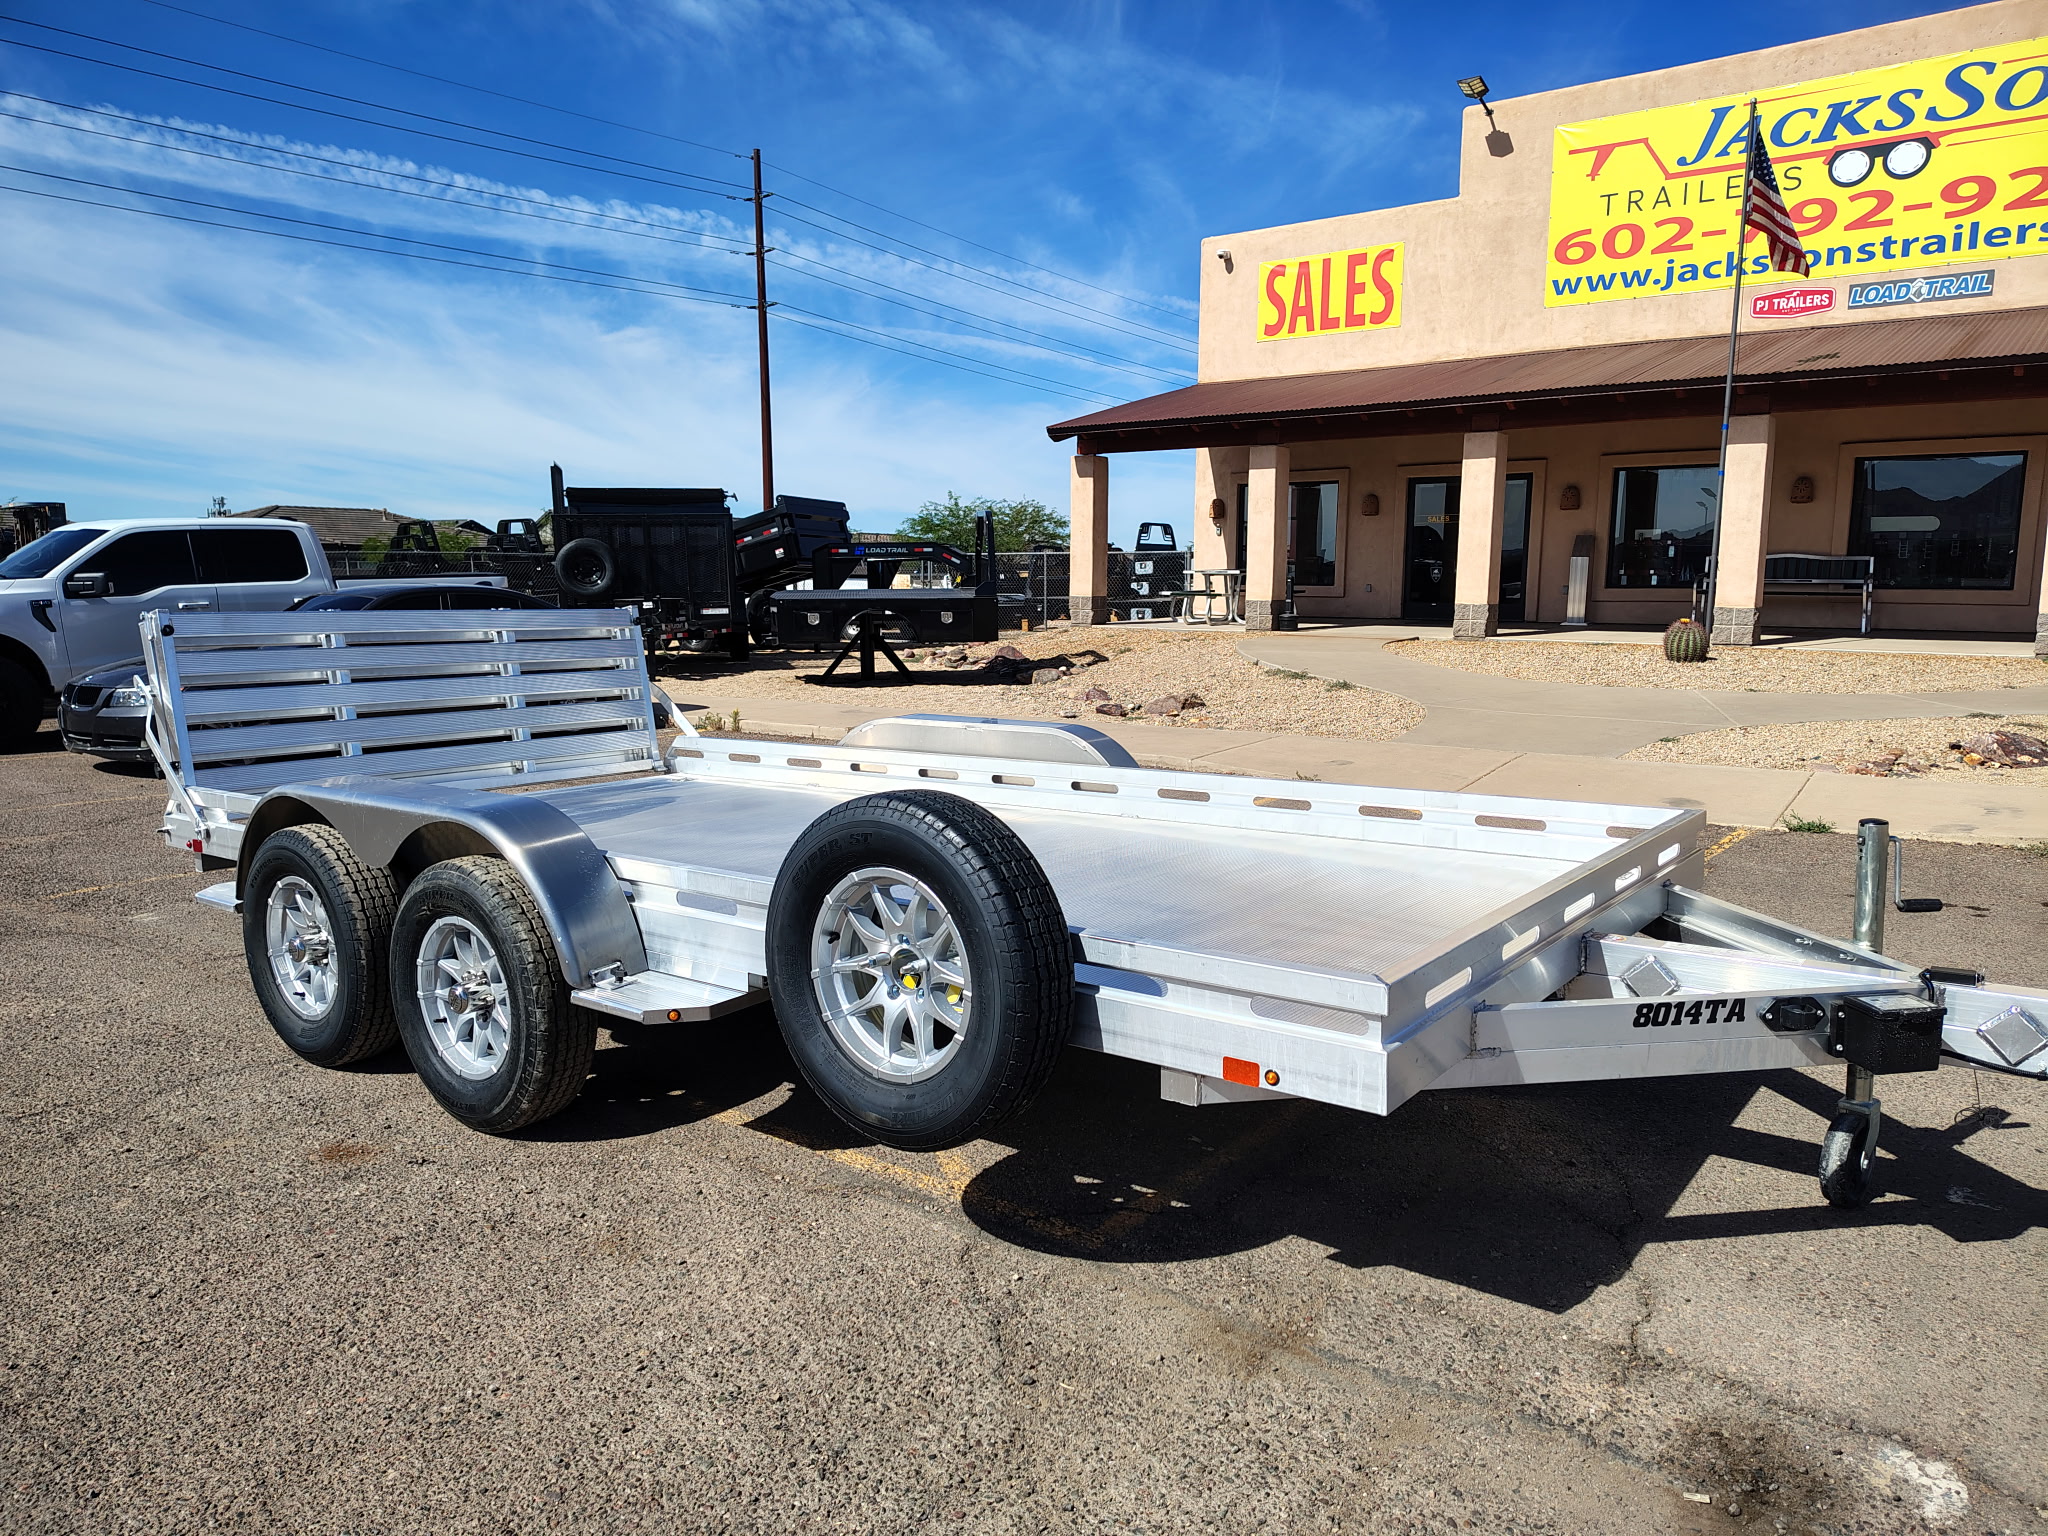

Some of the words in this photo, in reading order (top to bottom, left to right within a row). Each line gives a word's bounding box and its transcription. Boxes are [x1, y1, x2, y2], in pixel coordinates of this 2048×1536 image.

[1600, 166, 1802, 216] TRAILES
[1552, 221, 2048, 296] www.jacksonstrailer
[1264, 249, 1395, 336] SALES
[1756, 299, 1768, 312] PJ
[1773, 293, 1829, 310] TRAILERS
[1850, 283, 1911, 306] LOAD
[1925, 274, 1991, 298] TRAIL
[1632, 998, 1746, 1028] 8014TA
